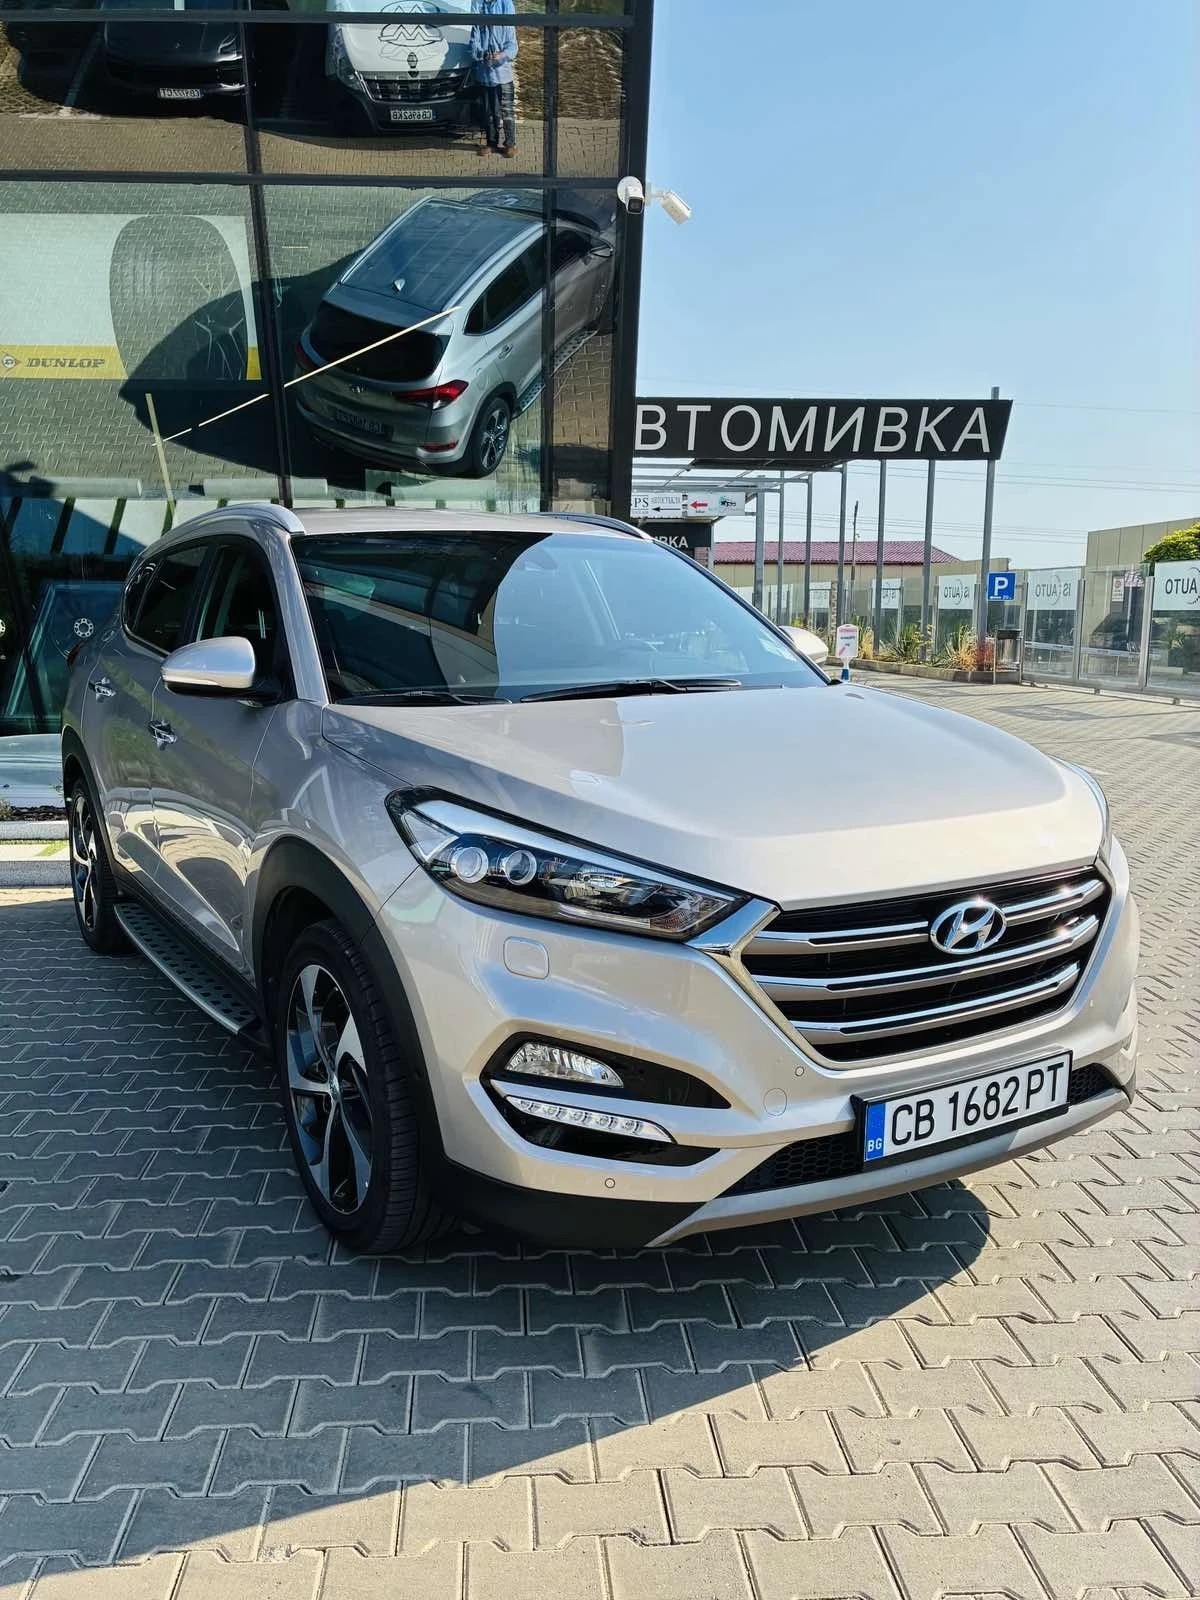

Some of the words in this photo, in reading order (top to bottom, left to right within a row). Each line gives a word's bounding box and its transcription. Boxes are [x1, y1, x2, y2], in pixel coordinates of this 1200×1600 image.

[26, 358, 105, 368] DUNLOP
[994, 576, 1009, 596] P
[891, 1098, 934, 1146] CB
[867, 1138, 883, 1152] BG
